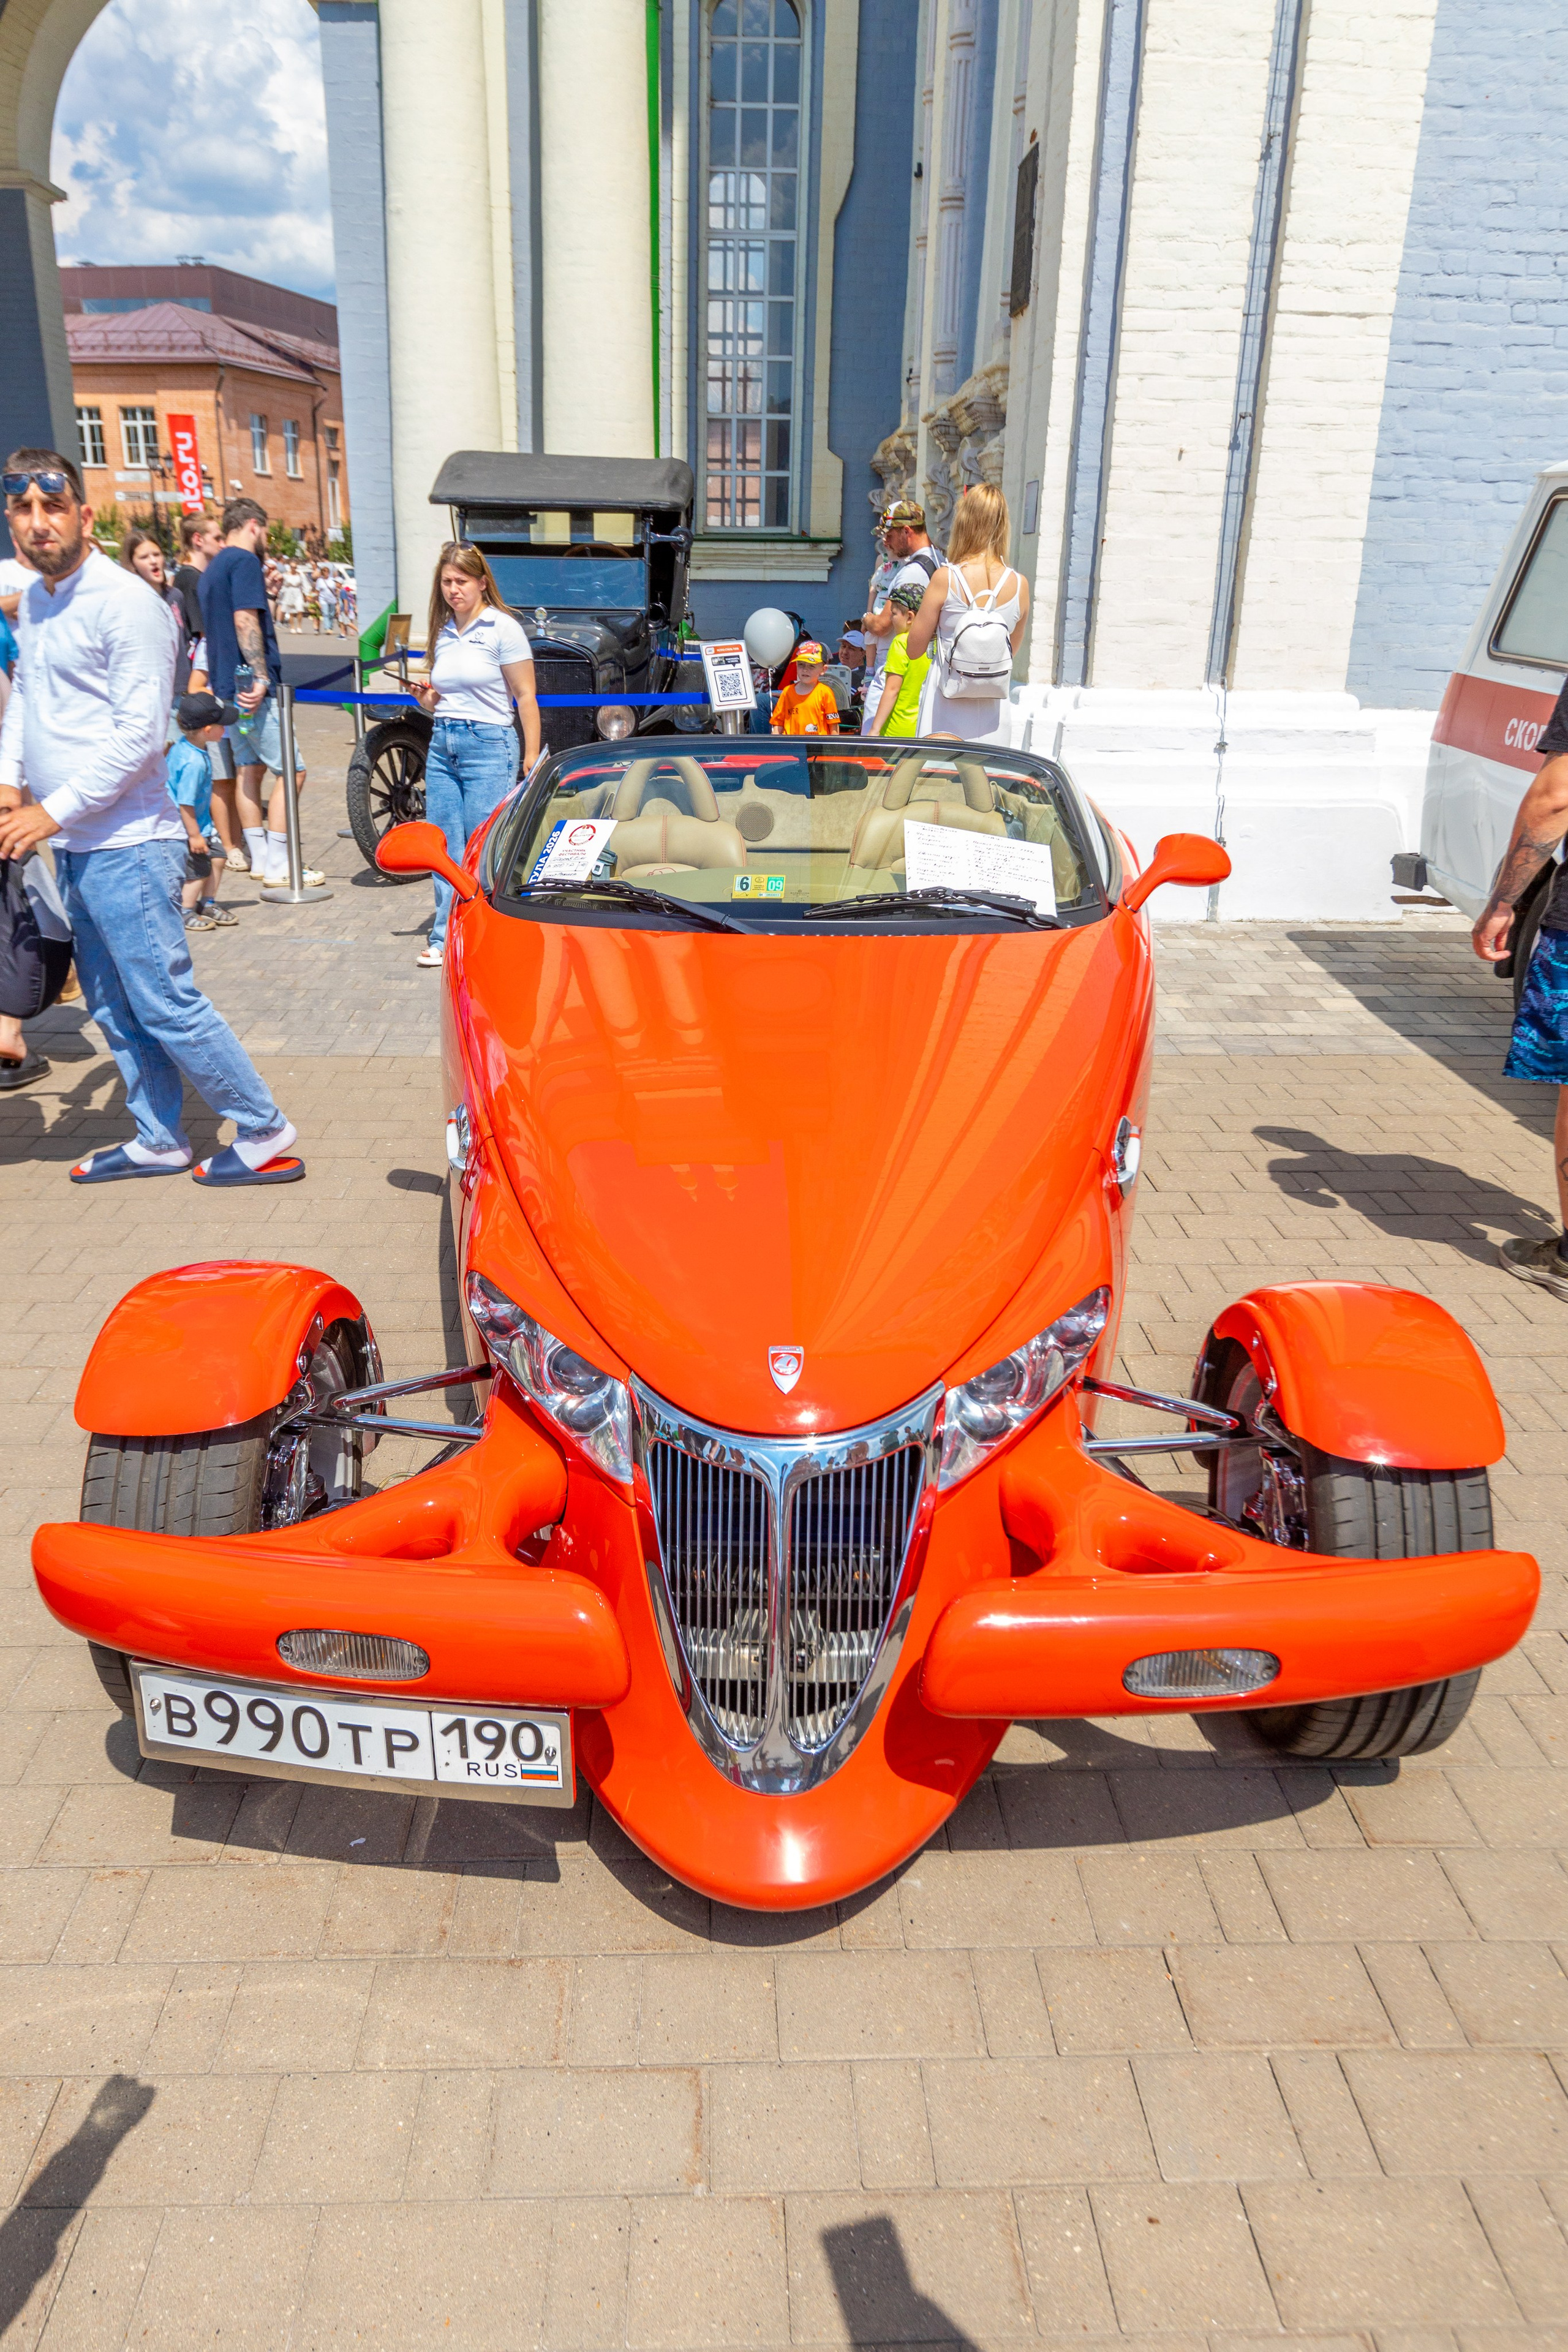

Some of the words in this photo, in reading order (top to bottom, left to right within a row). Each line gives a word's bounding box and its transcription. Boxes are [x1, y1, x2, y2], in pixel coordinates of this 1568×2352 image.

[529, 856, 548, 883] ТУЛА
[543, 831, 560, 854] 2026
[740, 876, 749, 891] 6
[767, 880, 783, 891] 09
[440, 1717, 545, 1762] 190
[467, 1762, 518, 1779] RUS
